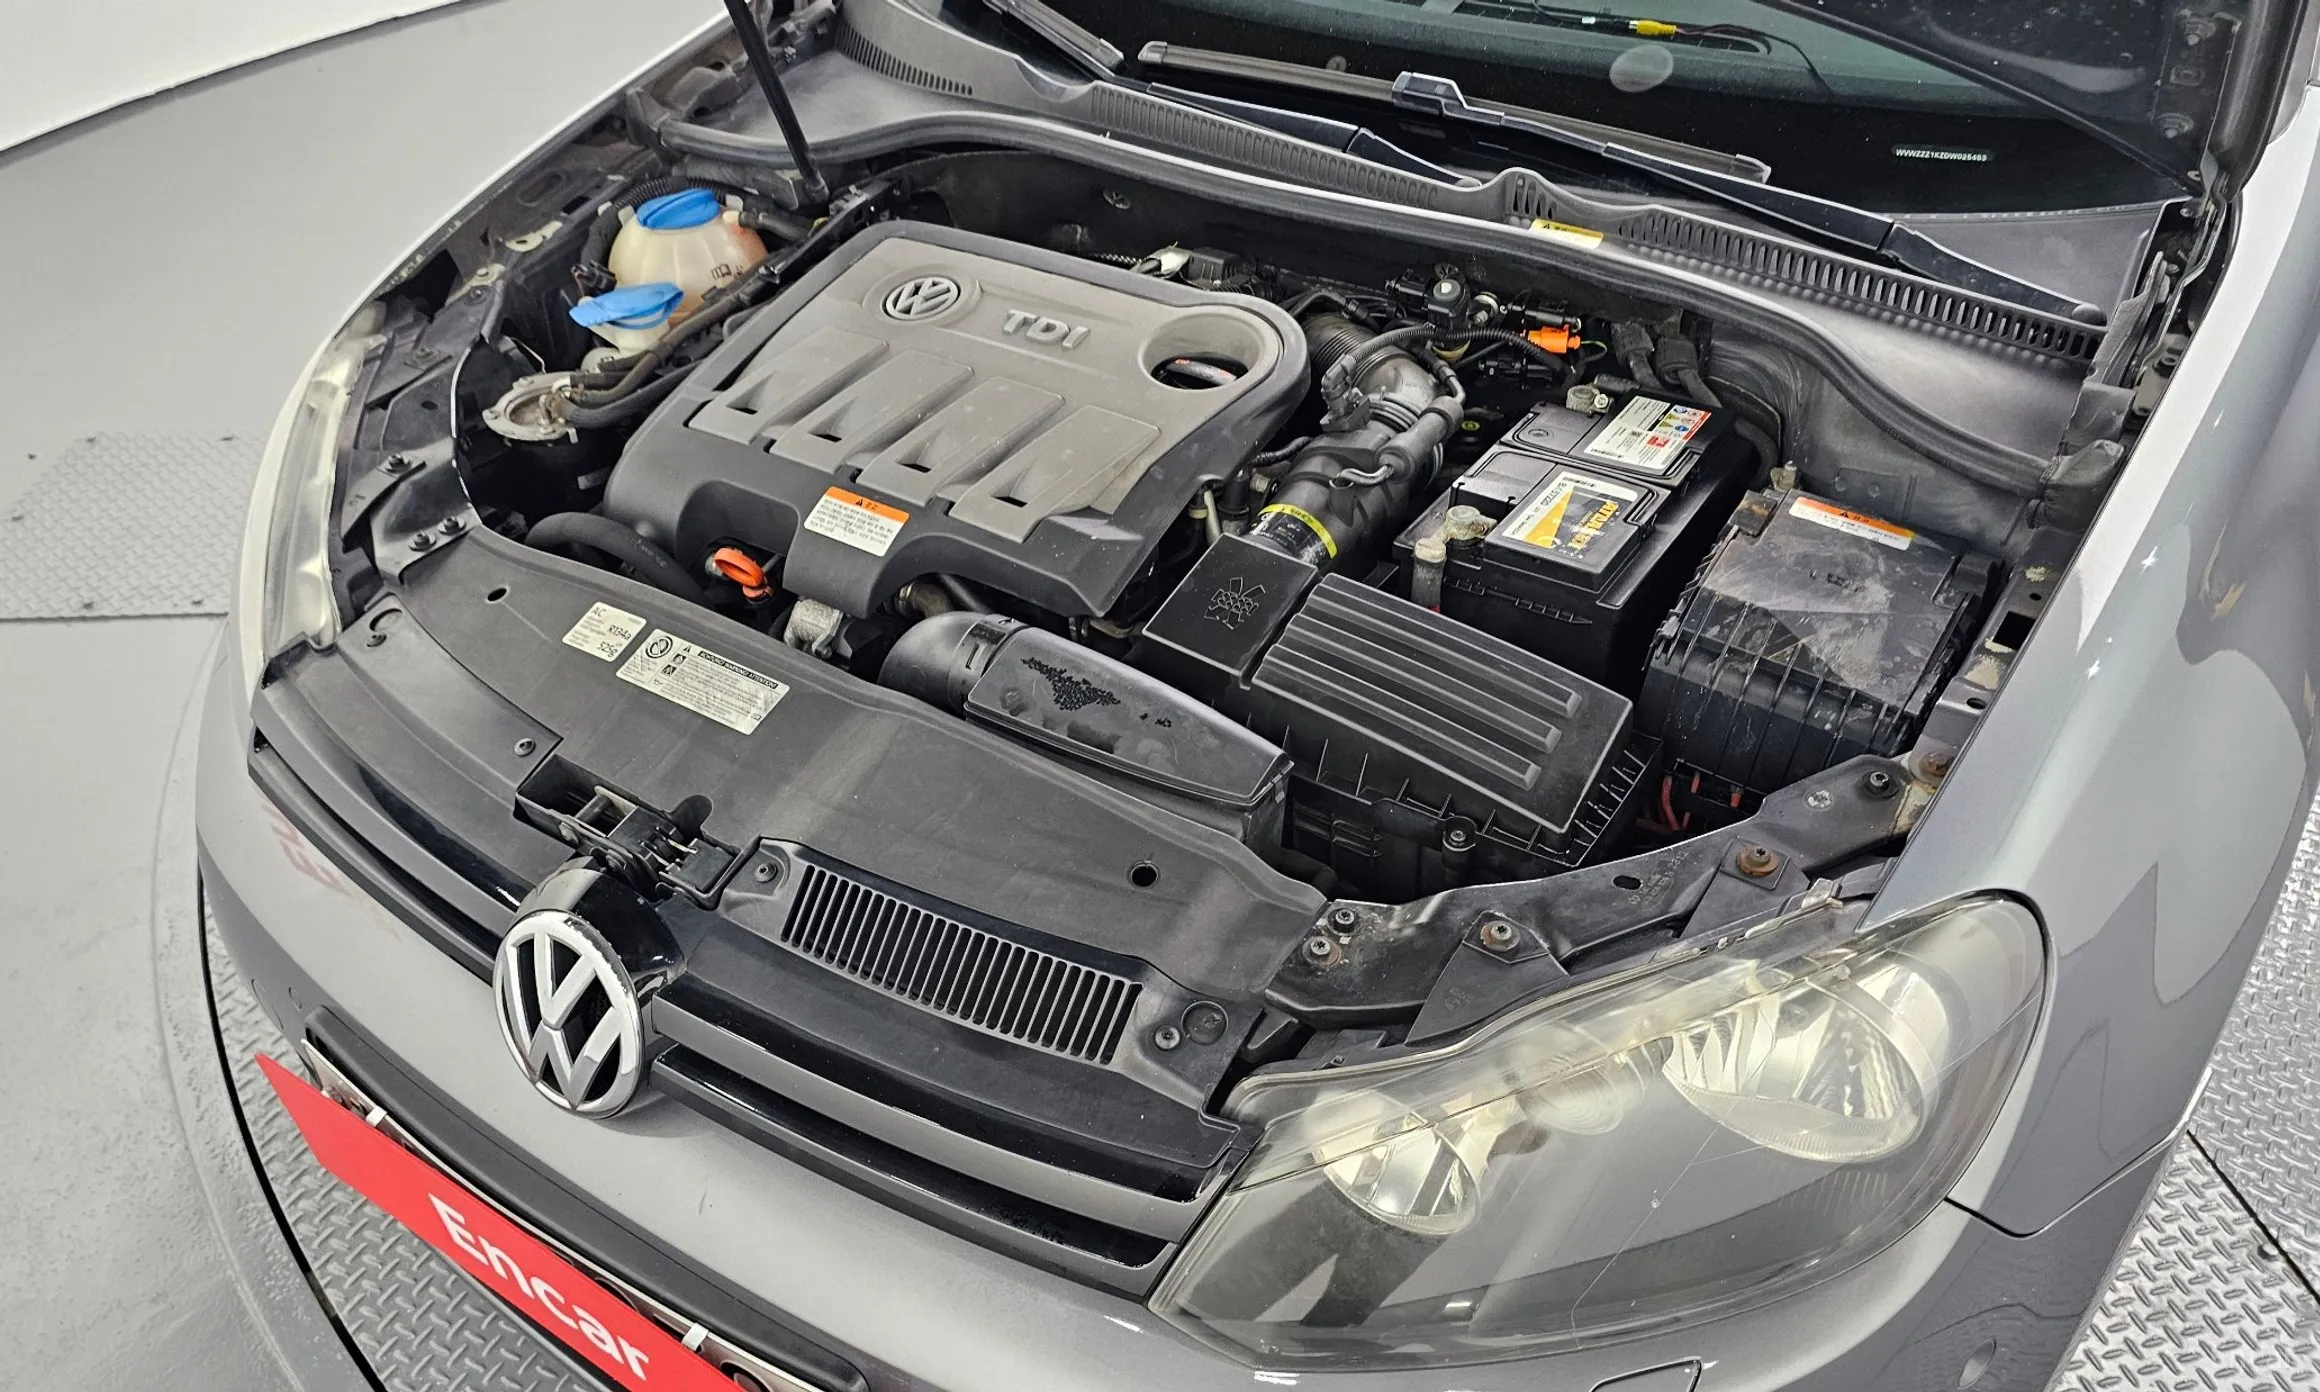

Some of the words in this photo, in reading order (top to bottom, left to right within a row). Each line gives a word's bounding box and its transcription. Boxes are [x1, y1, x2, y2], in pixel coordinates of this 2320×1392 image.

[1002, 308, 1090, 350] TDI
[608, 624, 632, 641] R134a
[427, 1192, 650, 1382] Encar
